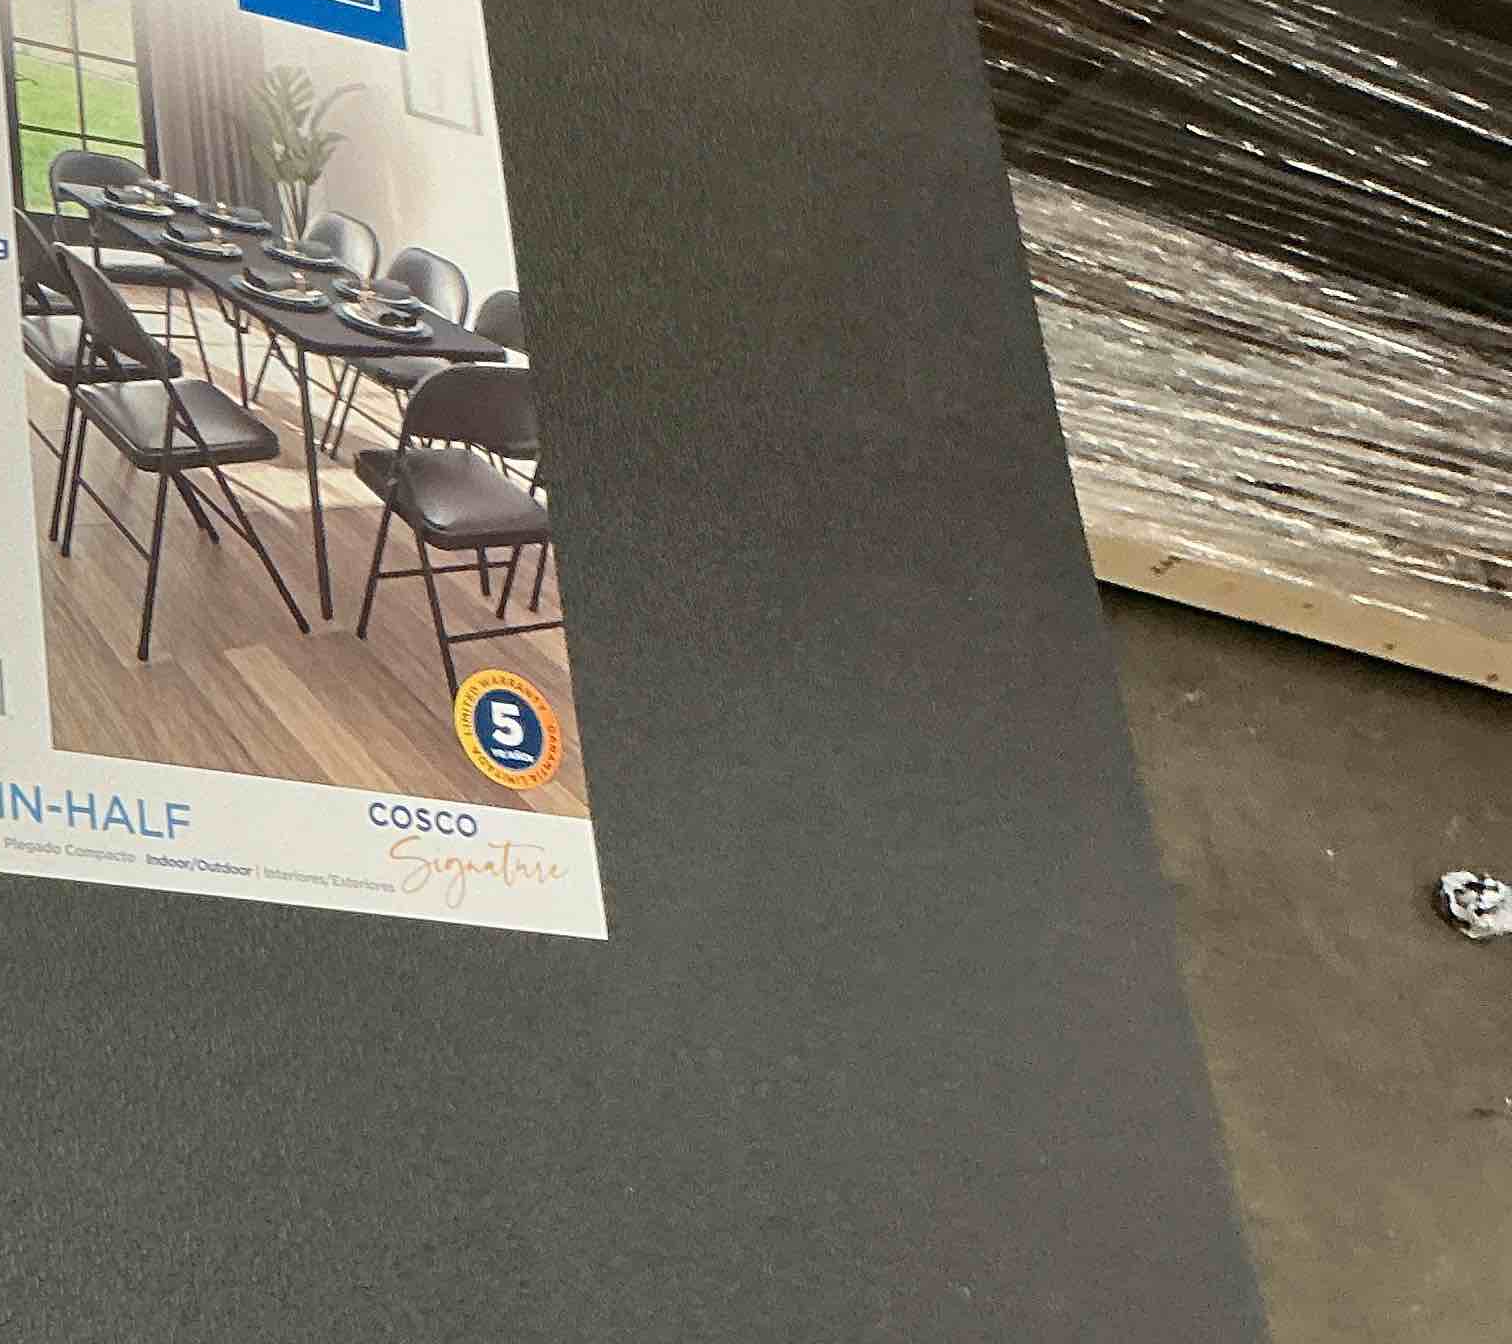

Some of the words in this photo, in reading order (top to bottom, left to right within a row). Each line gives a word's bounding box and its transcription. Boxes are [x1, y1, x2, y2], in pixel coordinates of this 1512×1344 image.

[491, 700, 525, 747] 5
[369, 800, 479, 838] COSCO
[145, 852, 253, 878] Indoor/Outdoor
[389, 834, 569, 910] Signature
